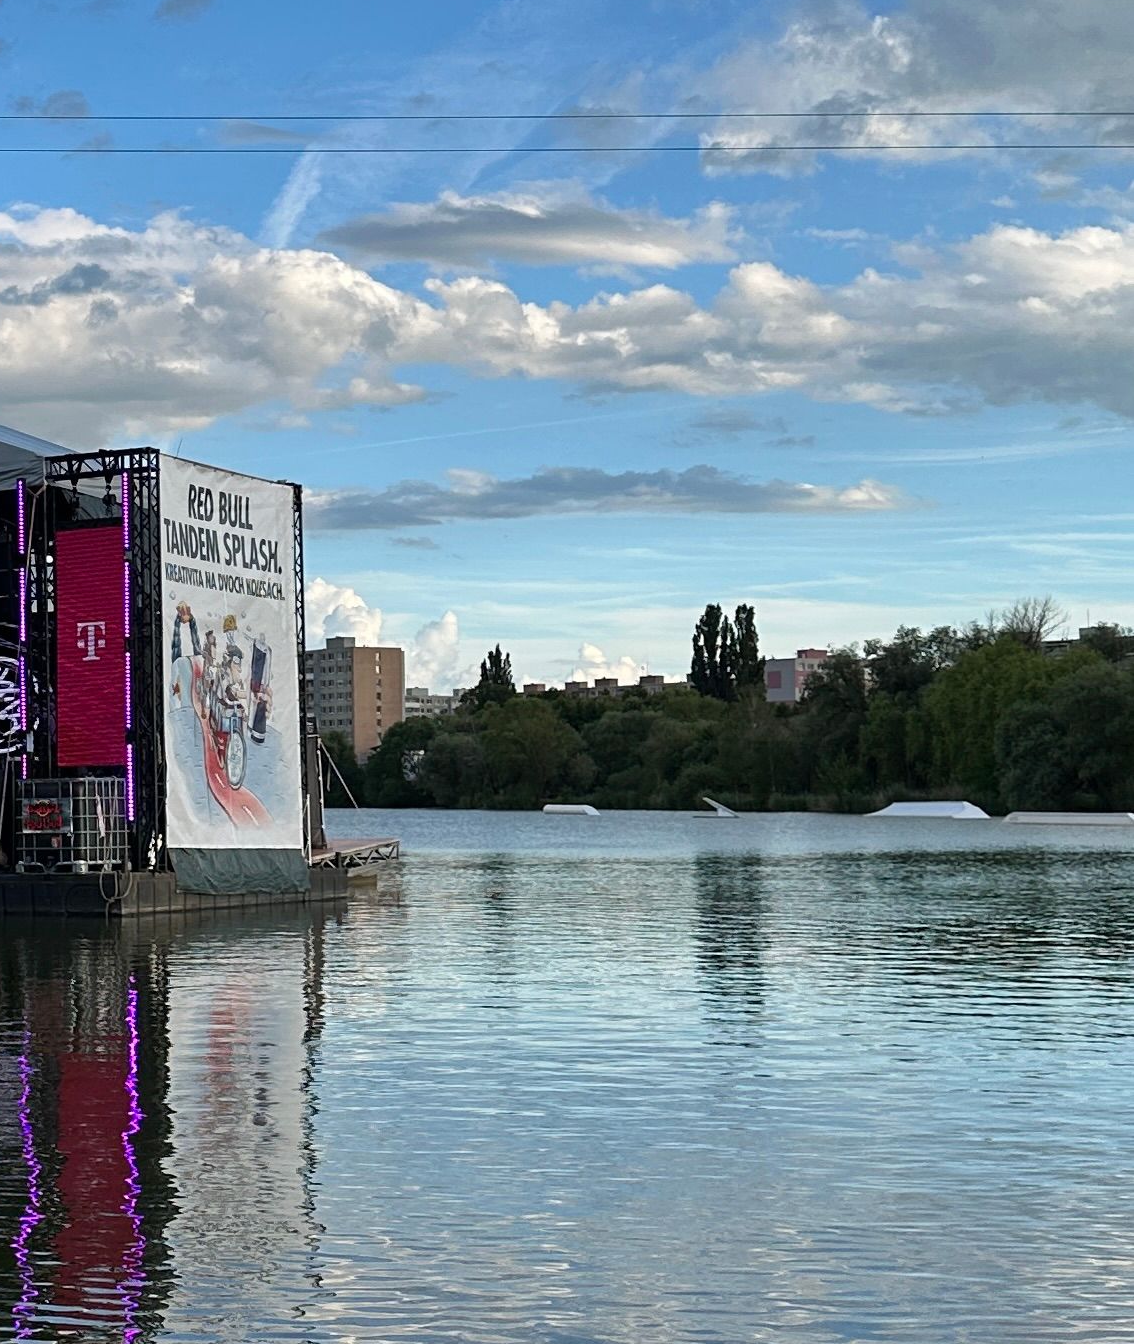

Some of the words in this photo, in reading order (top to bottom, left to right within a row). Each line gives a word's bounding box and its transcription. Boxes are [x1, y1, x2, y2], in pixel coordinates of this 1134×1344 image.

[188, 484, 214, 522] RED
[219, 491, 253, 530] BULL
[164, 518, 220, 564] TANDEM
[223, 532, 282, 575] SPLASH.
[165, 562, 204, 589] KREATIVITA
[205, 570, 217, 591] NA
[218, 573, 245, 594] DVOCH
